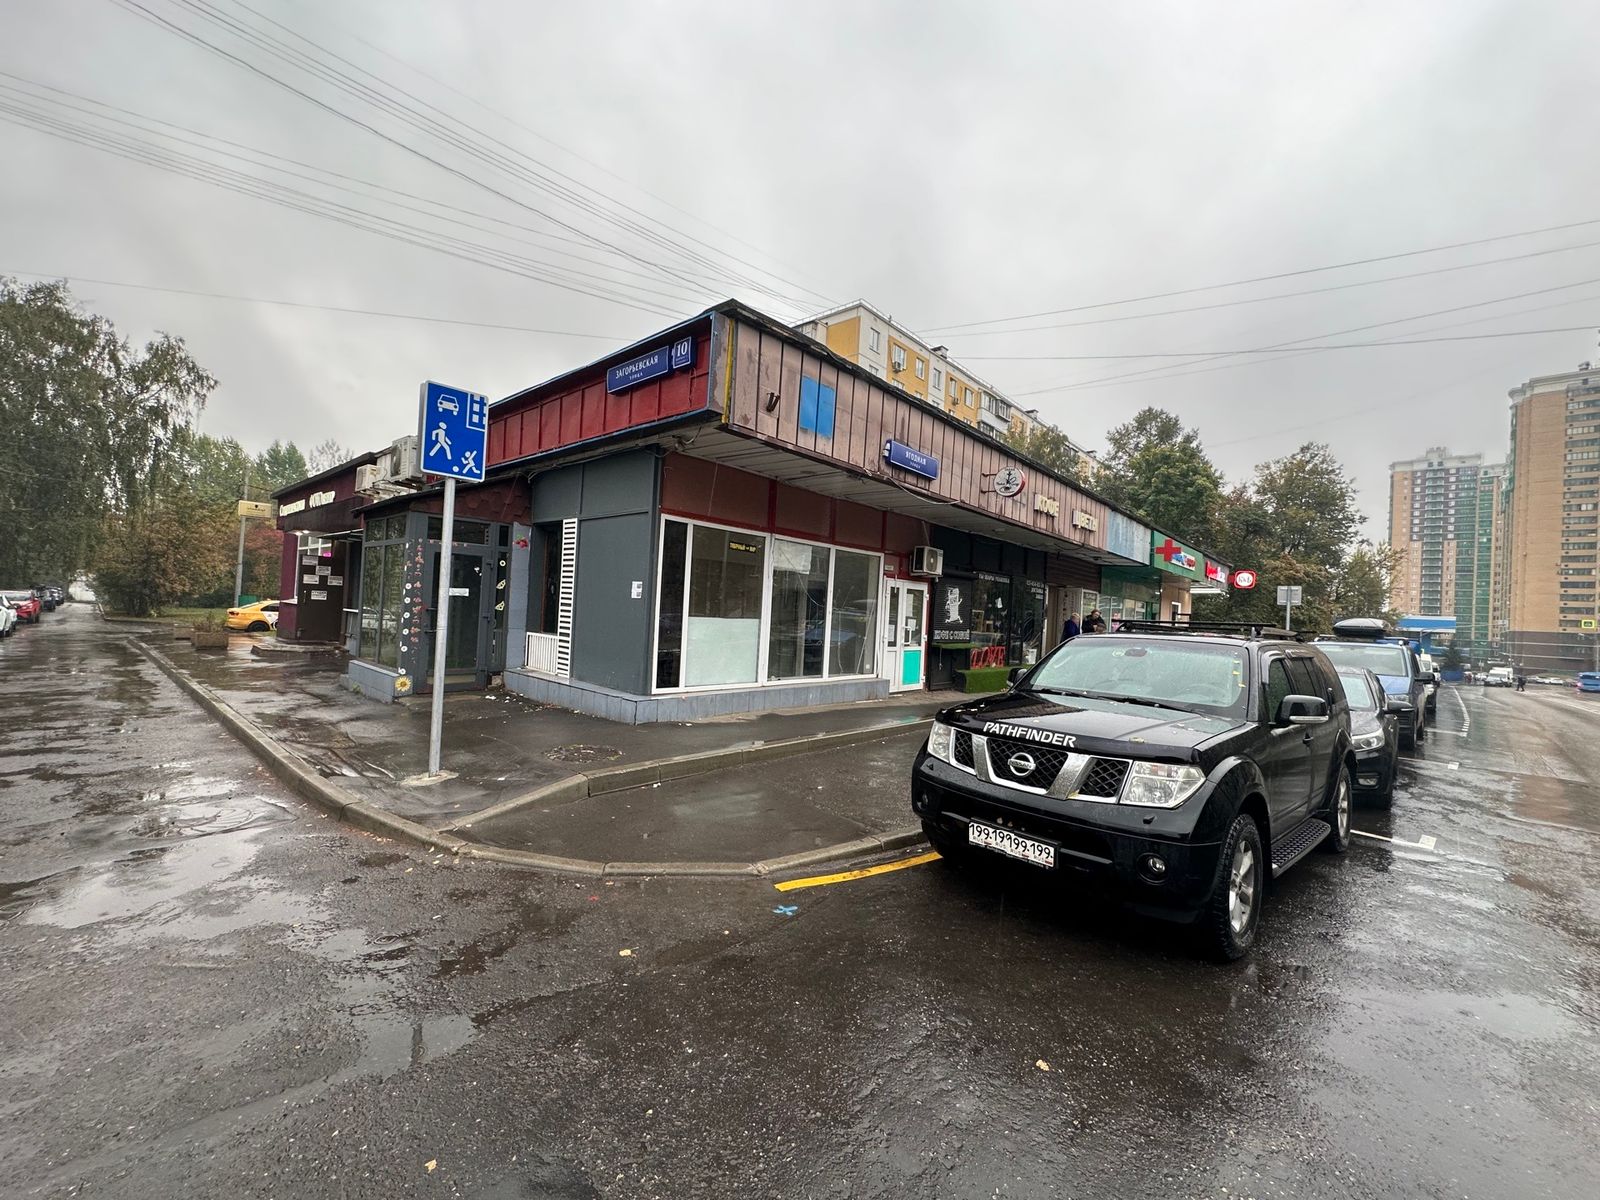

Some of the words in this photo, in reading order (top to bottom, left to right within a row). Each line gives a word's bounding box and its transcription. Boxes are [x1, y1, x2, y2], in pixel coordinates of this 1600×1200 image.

[677, 341, 688, 357] 10
[615, 355, 660, 379] ЗАГОРЬЕВСКАЯ
[905, 450, 927, 466] ЯГОДНАЯ
[1035, 493, 1060, 517] КОФЕ
[1072, 509, 1099, 531] ЦВЕТЫ
[970, 646, 1006, 669] LOVE
[983, 721, 1077, 748] PATHFINDER
[1009, 759, 1033, 770] NISSAN
